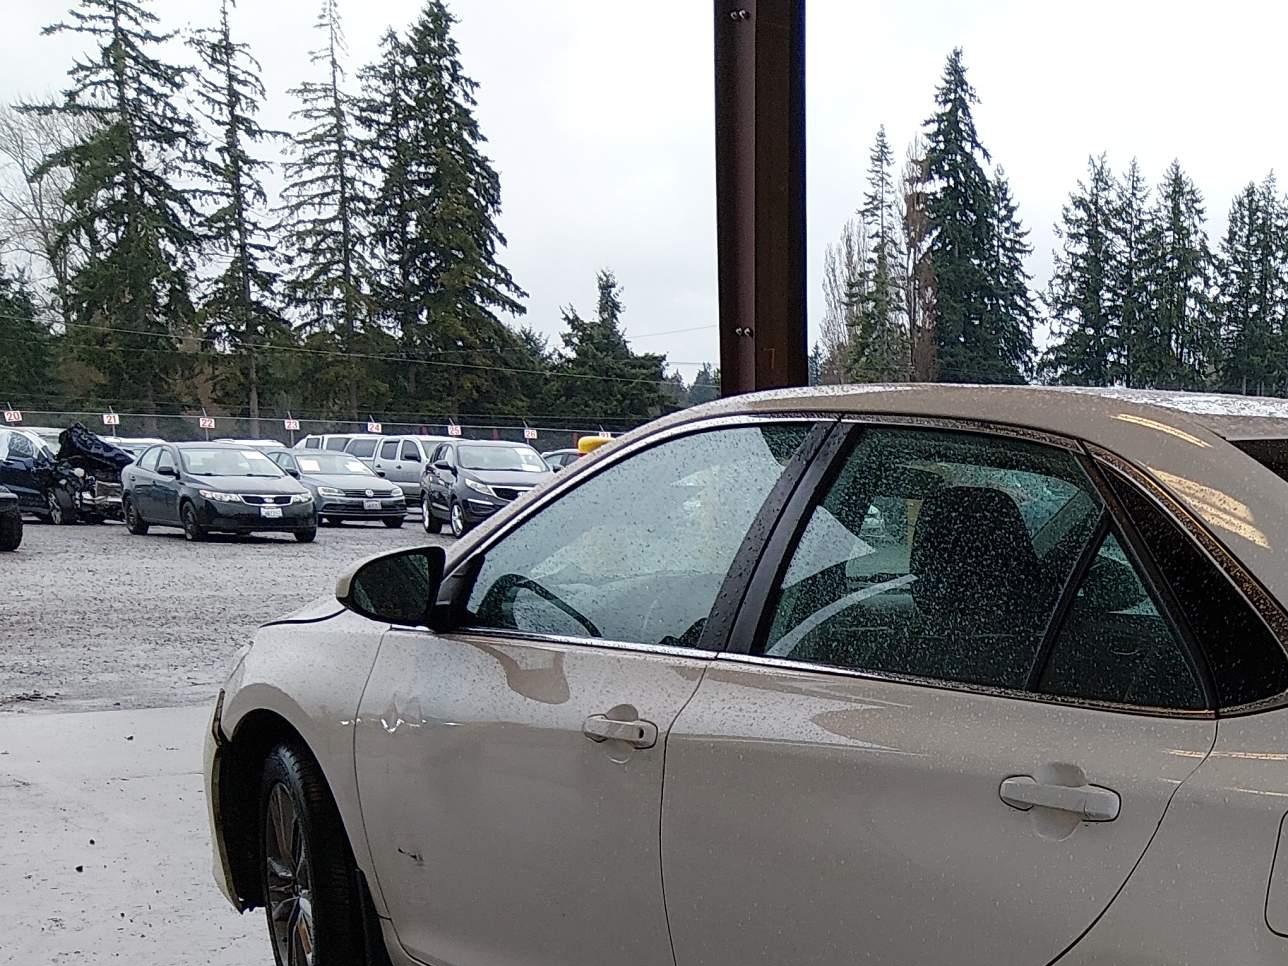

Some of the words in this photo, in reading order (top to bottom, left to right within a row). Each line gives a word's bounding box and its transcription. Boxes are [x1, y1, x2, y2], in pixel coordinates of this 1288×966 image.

[6, 412, 20, 421] 20
[106, 415, 117, 424] 21
[201, 418, 213, 428] 22
[286, 421, 298, 430] 23
[368, 423, 380, 432] 24
[449, 426, 460, 435] 25
[525, 430, 536, 438] 26
